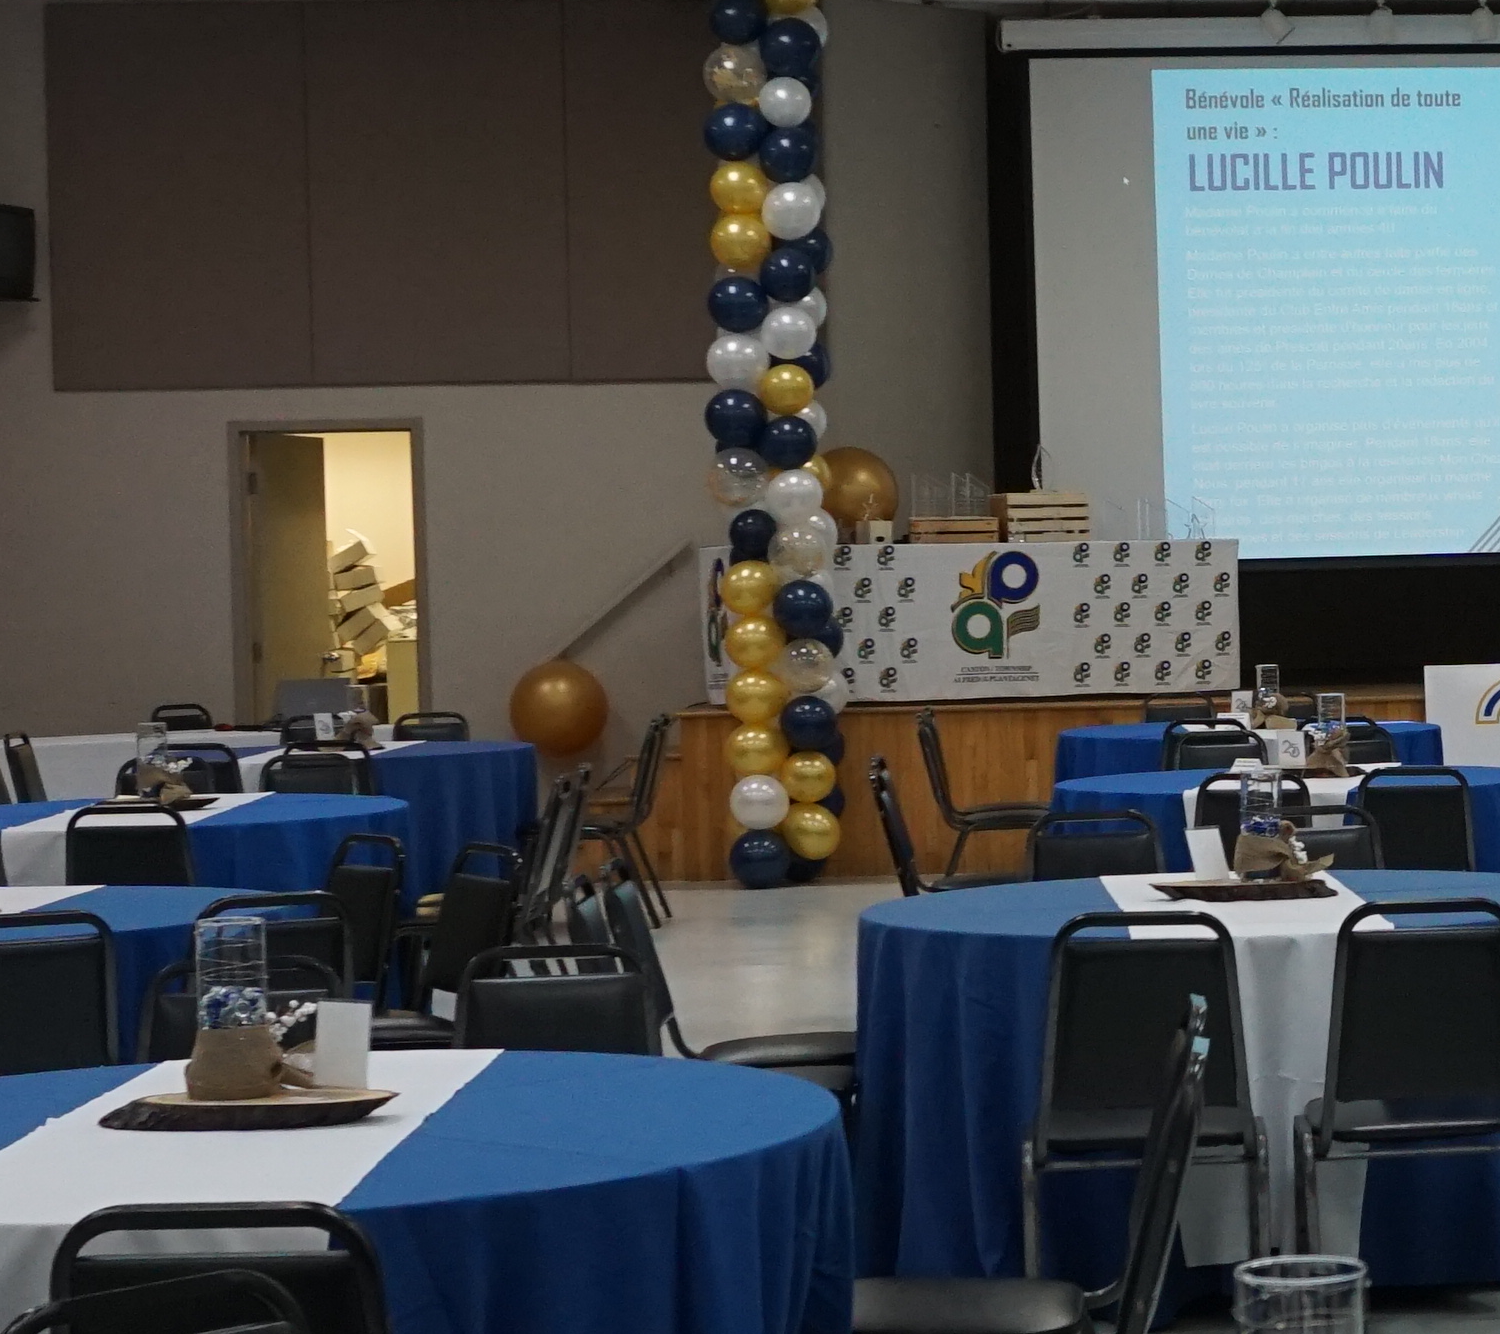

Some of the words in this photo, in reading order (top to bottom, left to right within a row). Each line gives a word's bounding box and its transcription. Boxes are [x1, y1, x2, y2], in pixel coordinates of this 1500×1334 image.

[1185, 87, 1265, 109] Bénévole
[1289, 87, 1385, 109] Réalisation
[1390, 87, 1411, 108] de
[1416, 89, 1461, 107] toute
[1186, 125, 1218, 141] une
[1224, 121, 1249, 140] vie
[1188, 153, 1316, 191] LUCILLE
[1328, 151, 1444, 190] POULIN
